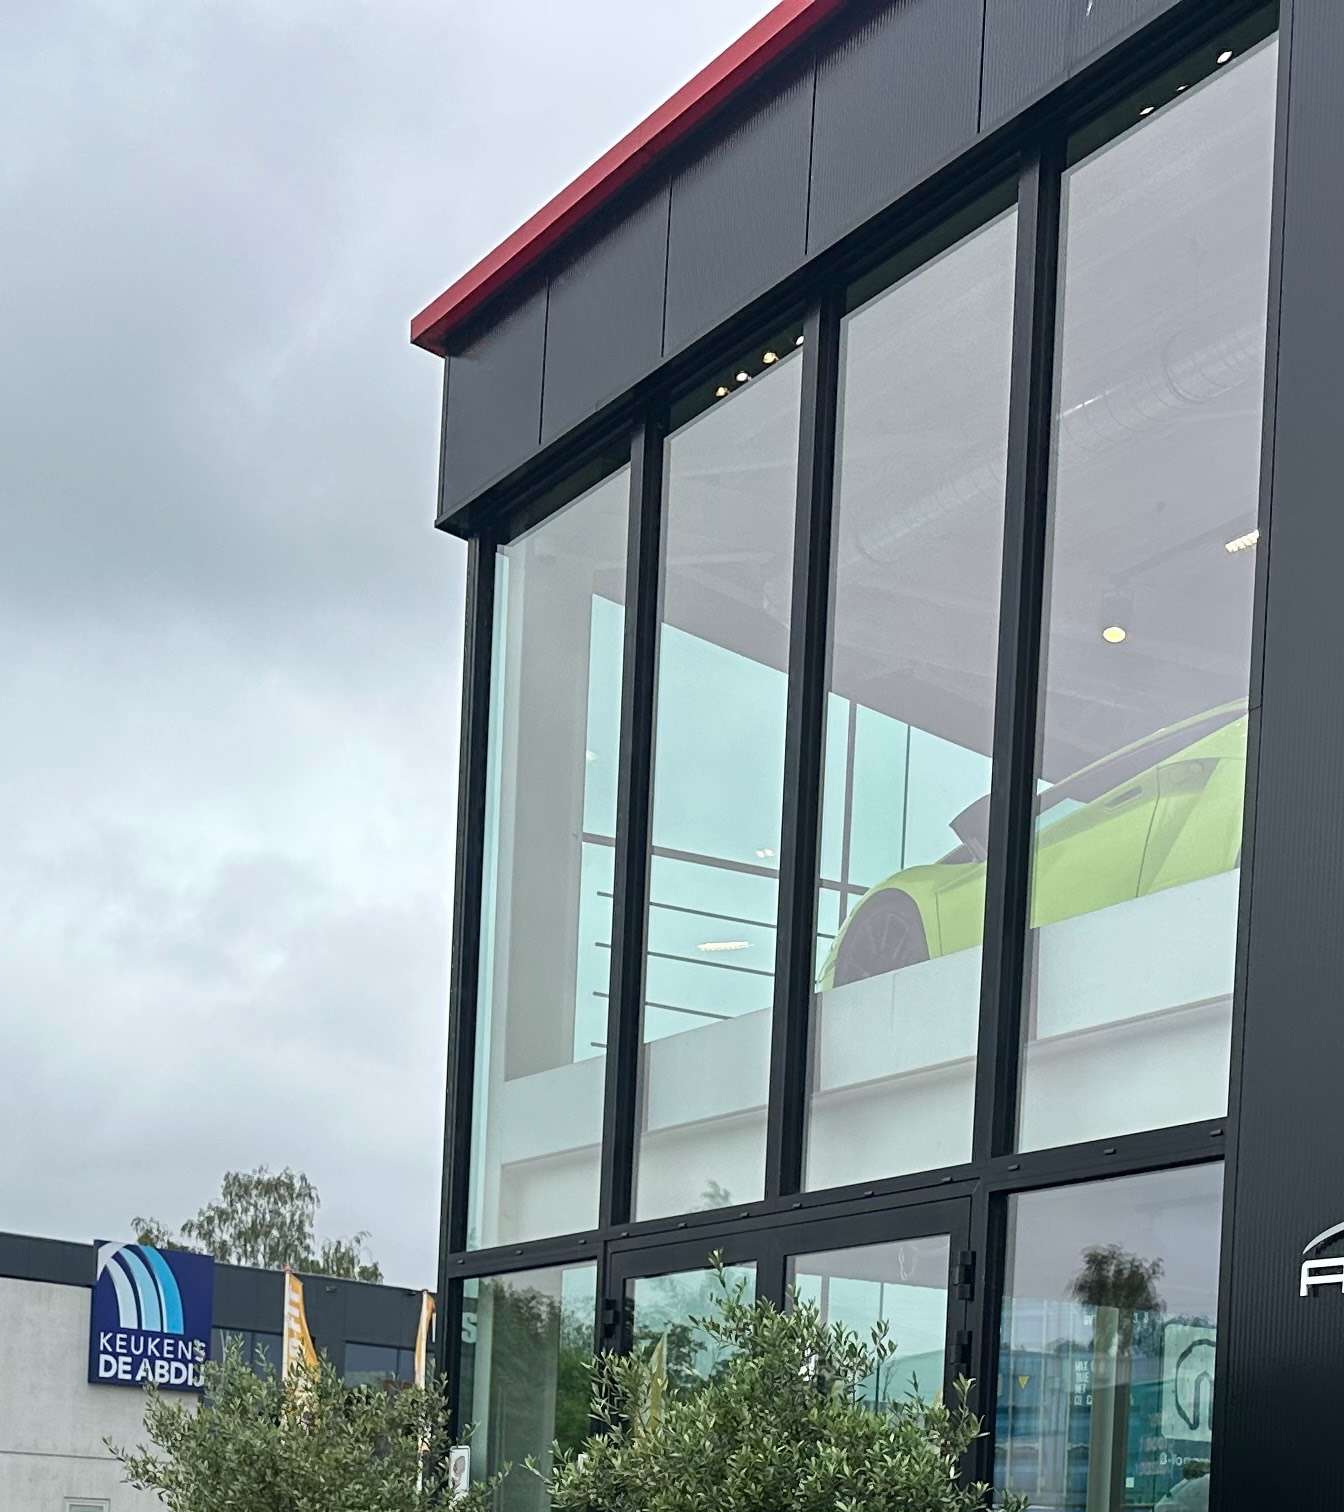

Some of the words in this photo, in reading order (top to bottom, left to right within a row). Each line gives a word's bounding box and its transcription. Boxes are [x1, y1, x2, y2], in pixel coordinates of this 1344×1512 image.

[99, 1331, 206, 1362] KEUKENS
[98, 1353, 133, 1380] DE
[135, 1358, 205, 1387] ABDIJ
